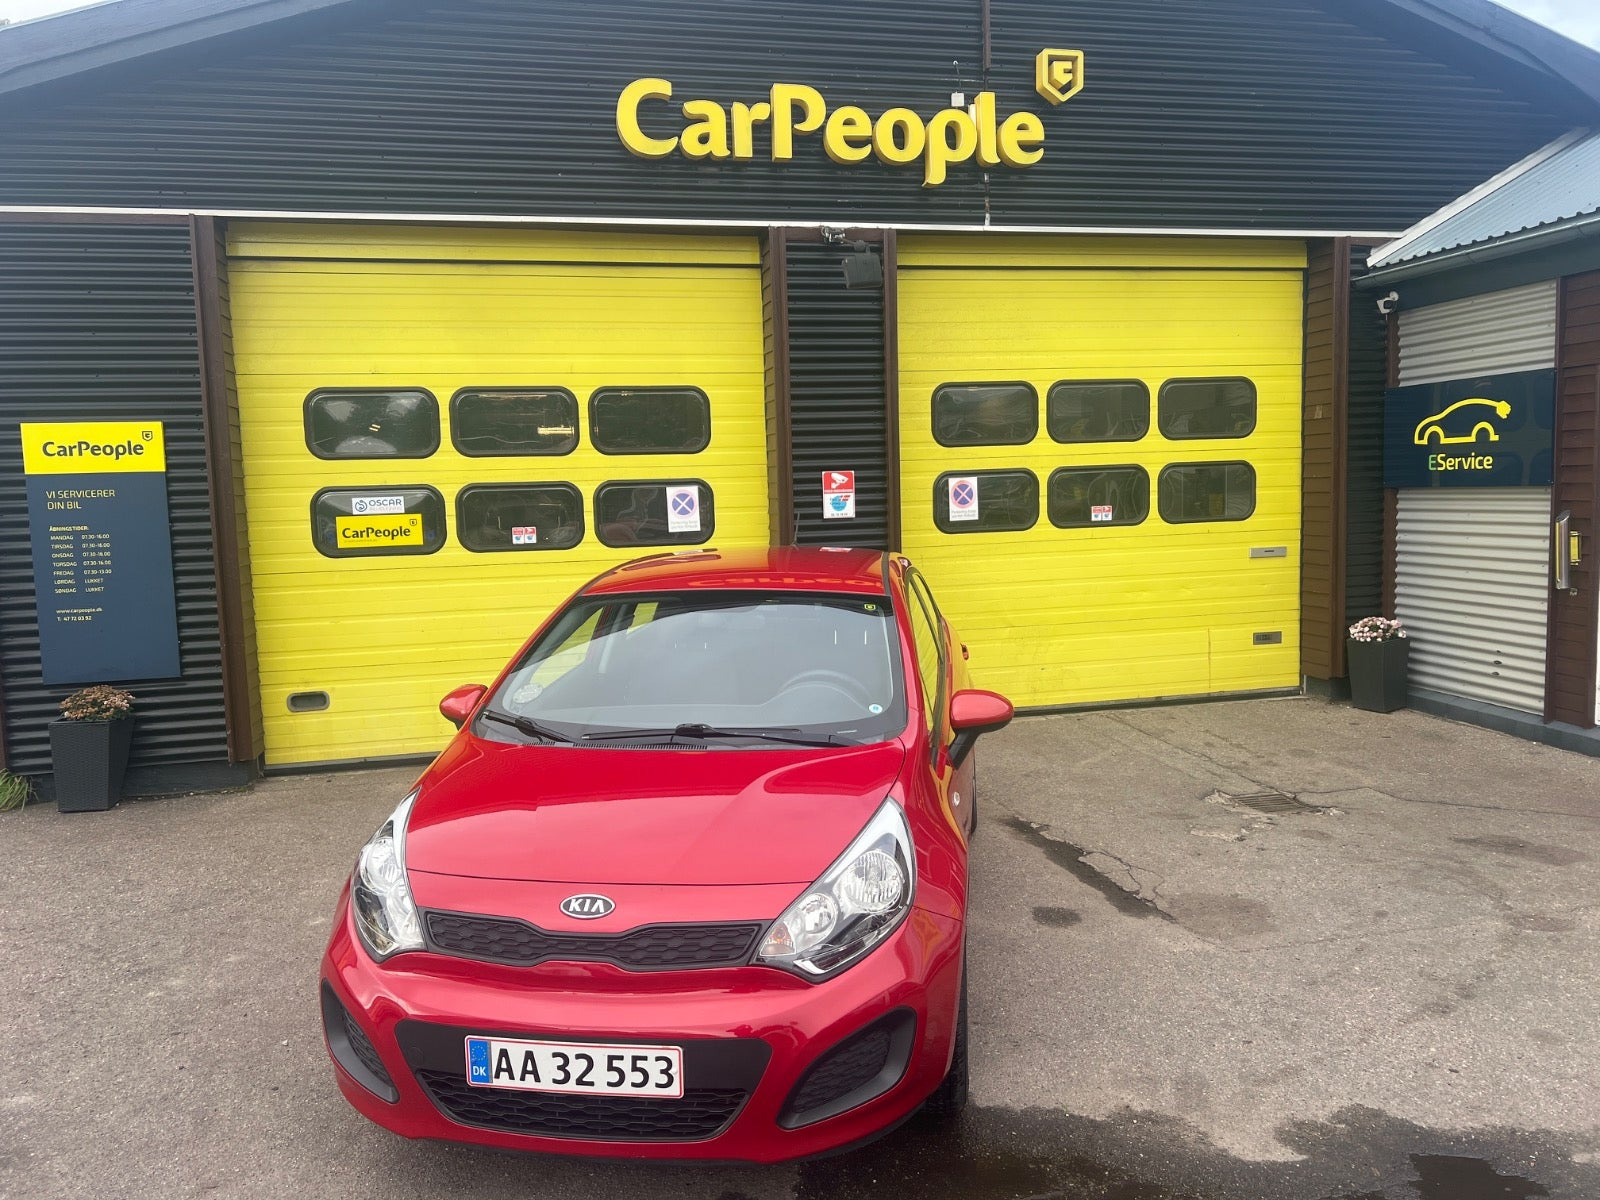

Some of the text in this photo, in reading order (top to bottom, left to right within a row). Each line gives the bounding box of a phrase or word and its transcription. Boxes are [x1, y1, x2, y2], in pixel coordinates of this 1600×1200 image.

[616, 77, 1046, 188] CarPeople
[42, 440, 144, 461] CarPeople
[1428, 452, 1494, 471] EService
[46, 489, 116, 499] VI SERVICERER
[47, 501, 83, 510] DIN BIL
[368, 498, 402, 507] OSCAR
[342, 526, 411, 541] CarPeople
[568, 898, 605, 913] KIA
[472, 1065, 487, 1077] DK
[494, 1048, 675, 1089] AA 32 553
